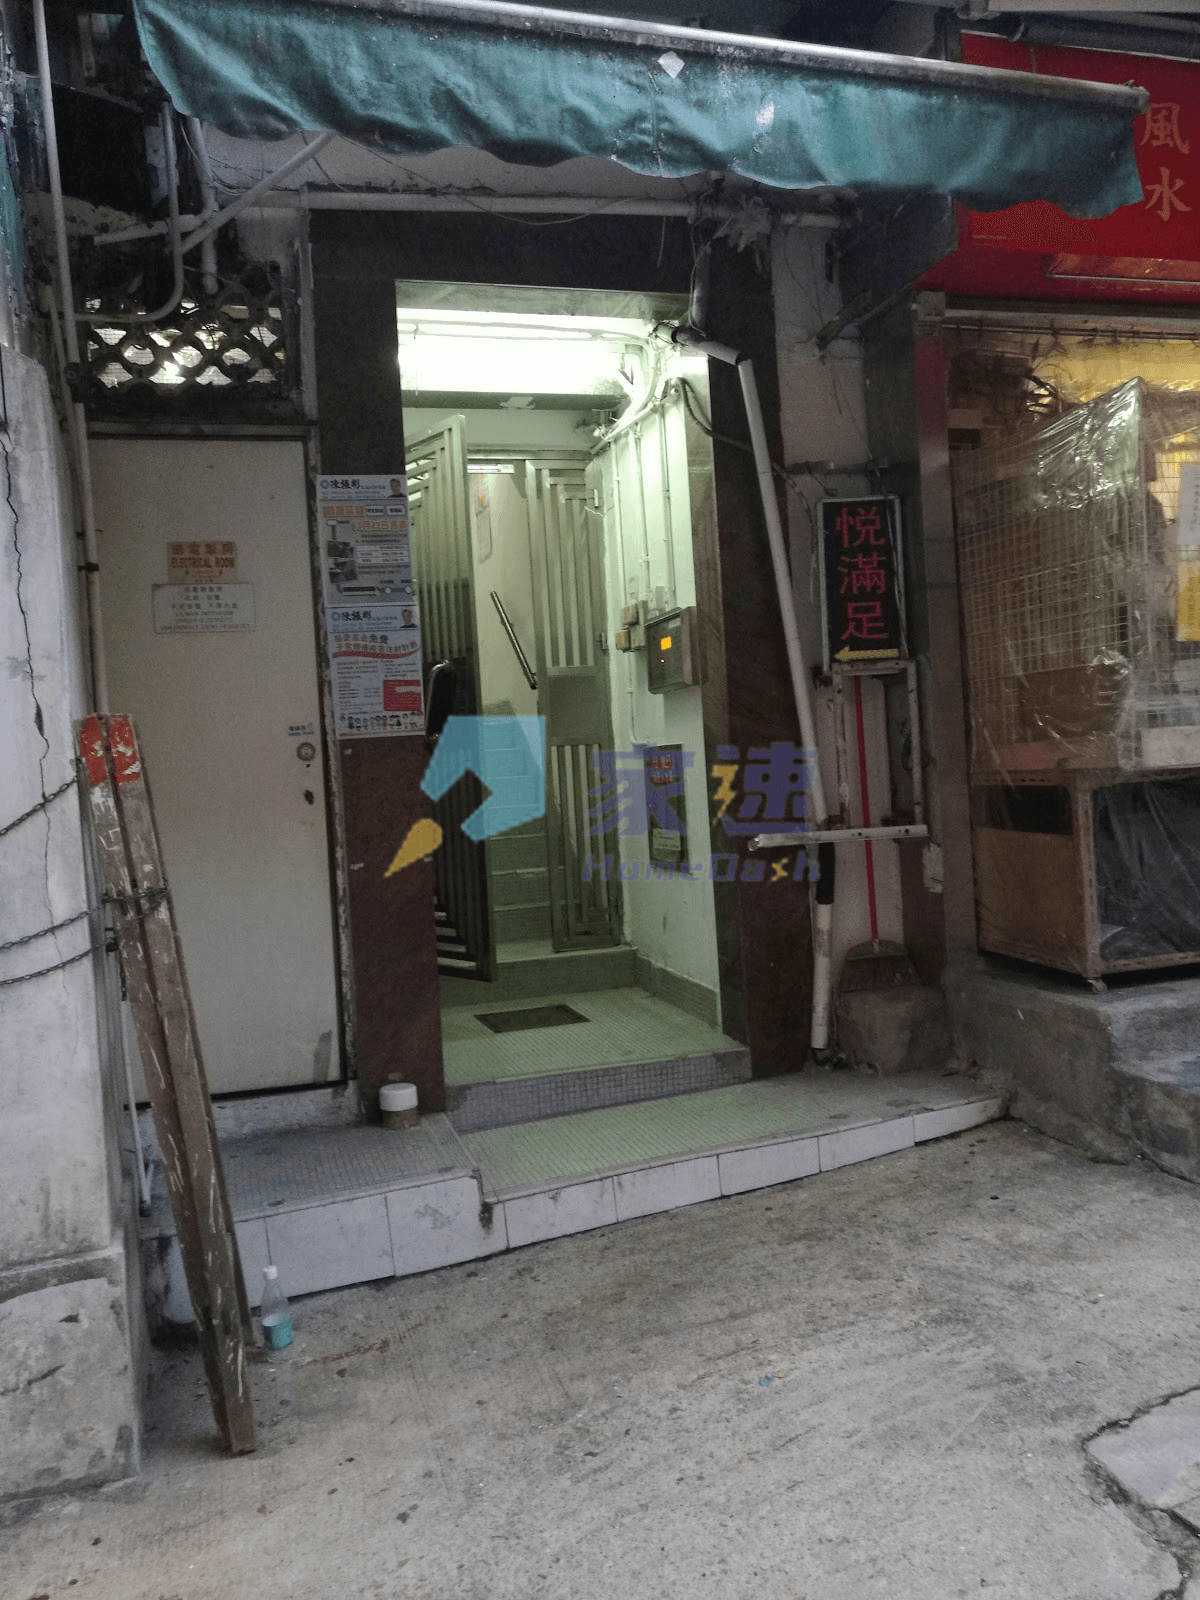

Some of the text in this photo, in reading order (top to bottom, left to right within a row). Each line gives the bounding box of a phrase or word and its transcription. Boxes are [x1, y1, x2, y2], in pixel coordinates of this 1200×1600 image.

[1140, 102, 1192, 221] 風水
[836, 506, 889, 640] 悅滿足
